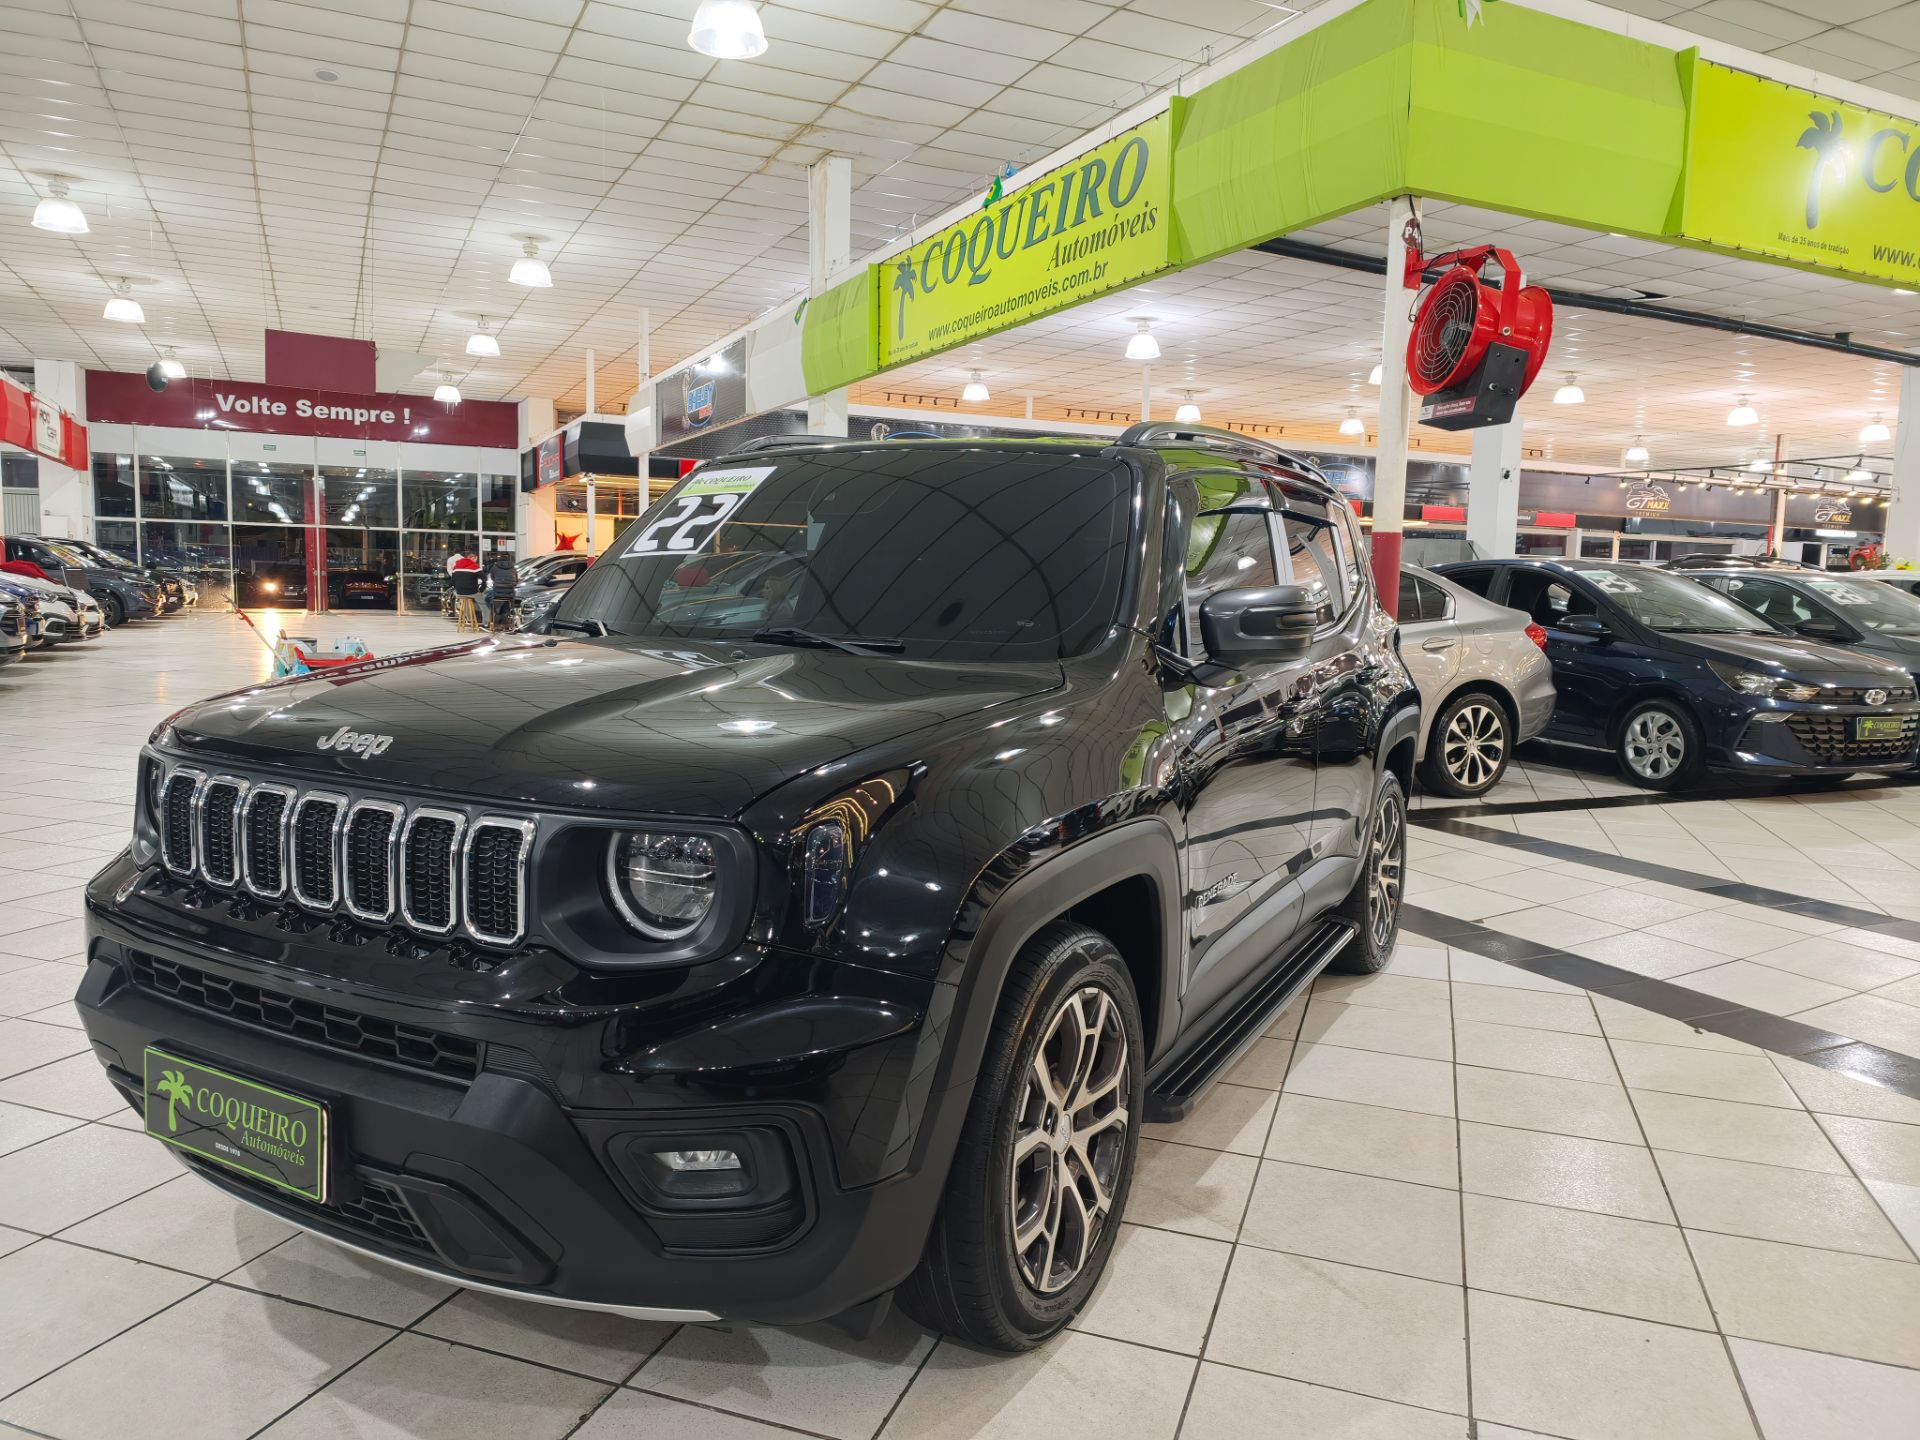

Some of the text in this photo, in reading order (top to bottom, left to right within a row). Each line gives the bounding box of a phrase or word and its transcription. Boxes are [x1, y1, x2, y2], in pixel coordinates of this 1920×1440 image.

[920, 136, 1149, 294] COQUEIRO
[1047, 200, 1157, 271] Automóveis
[928, 260, 1108, 341] www.coqueiroautomoveis.com.br
[215, 393, 411, 425] Volte Sempre !
[633, 493, 739, 551] 22
[316, 726, 394, 759] Jeep
[197, 1088, 307, 1147] COQUEIRO
[240, 1130, 305, 1166] Automóveis
